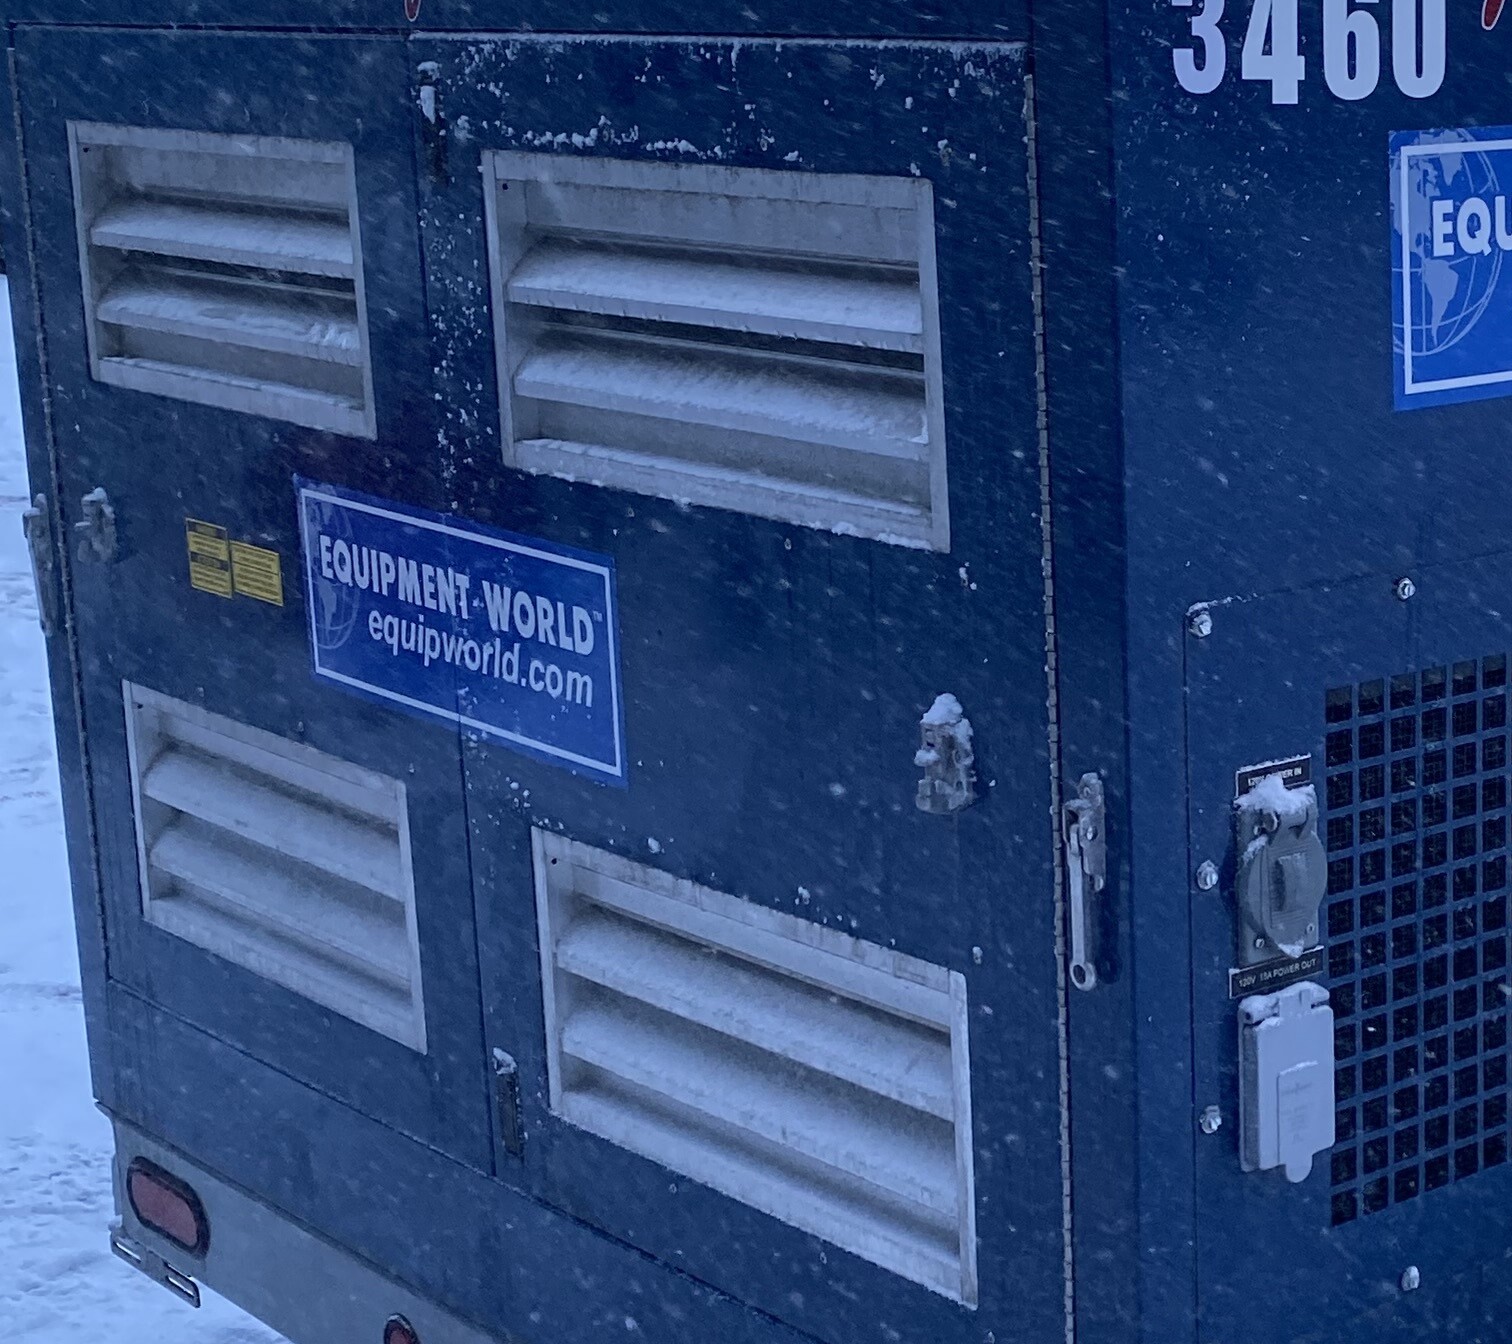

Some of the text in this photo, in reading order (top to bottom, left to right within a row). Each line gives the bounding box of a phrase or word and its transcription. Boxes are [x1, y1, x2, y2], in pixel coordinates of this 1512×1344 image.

[319, 534, 470, 620] EQUIPMENT
[368, 609, 593, 707] equipworld.com
[1273, 962, 1301, 978] POWER
[1301, 958, 1317, 971] OUT
